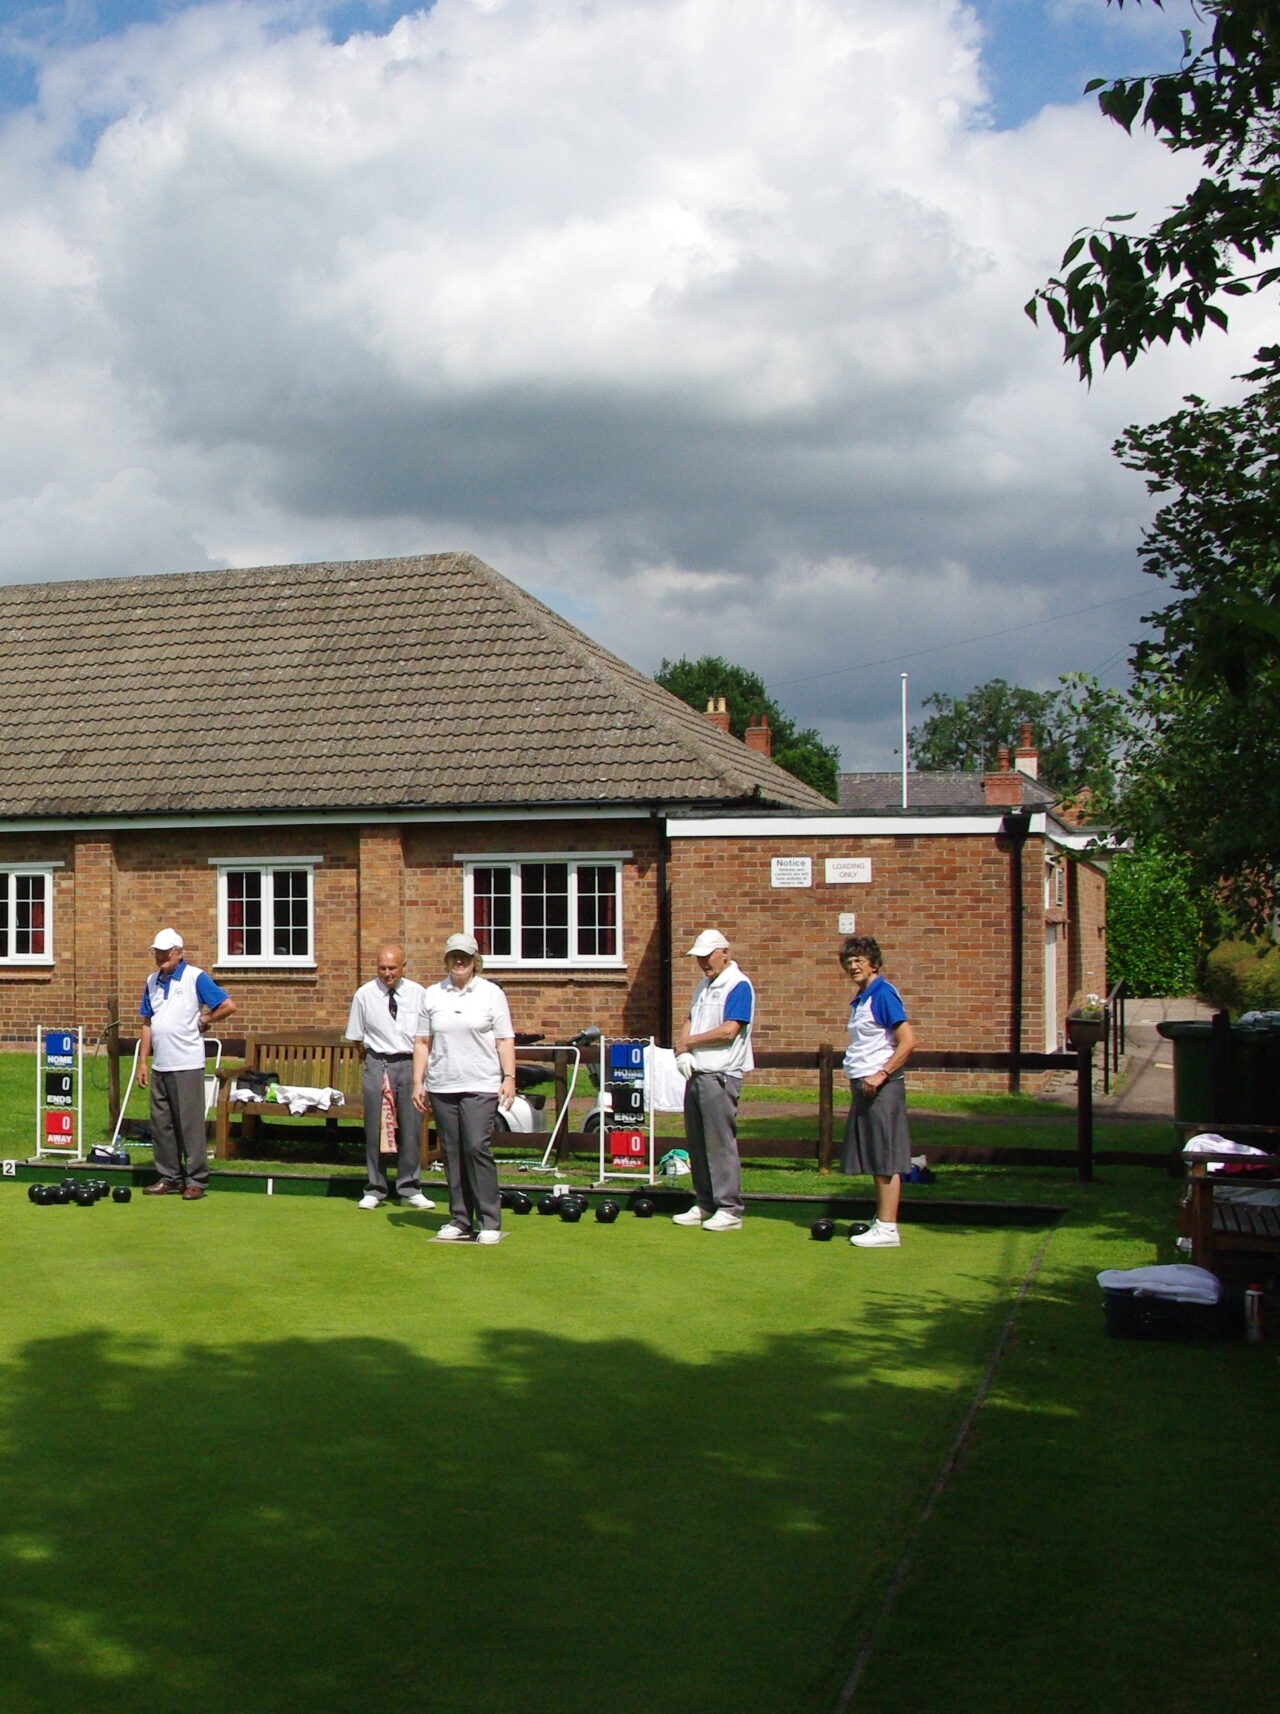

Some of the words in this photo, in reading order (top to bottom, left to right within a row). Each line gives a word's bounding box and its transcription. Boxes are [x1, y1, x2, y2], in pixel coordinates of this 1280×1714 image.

[776, 859, 806, 867] Notice
[63, 1036, 71, 1051] 0
[47, 1055, 73, 1064] HOME
[631, 1048, 641, 1064] 0
[613, 1068, 644, 1078] HOME
[62, 1076, 70, 1090] 0
[46, 1095, 72, 1104] ENDS
[631, 1092, 640, 1107] 0
[614, 1112, 644, 1121] ENDS
[62, 1116, 70, 1130] 0
[47, 1134, 72, 1143] AWAY
[631, 1136, 640, 1151] 0
[613, 1156, 642, 1165] AWAY
[5, 1162, 13, 1174] 2
